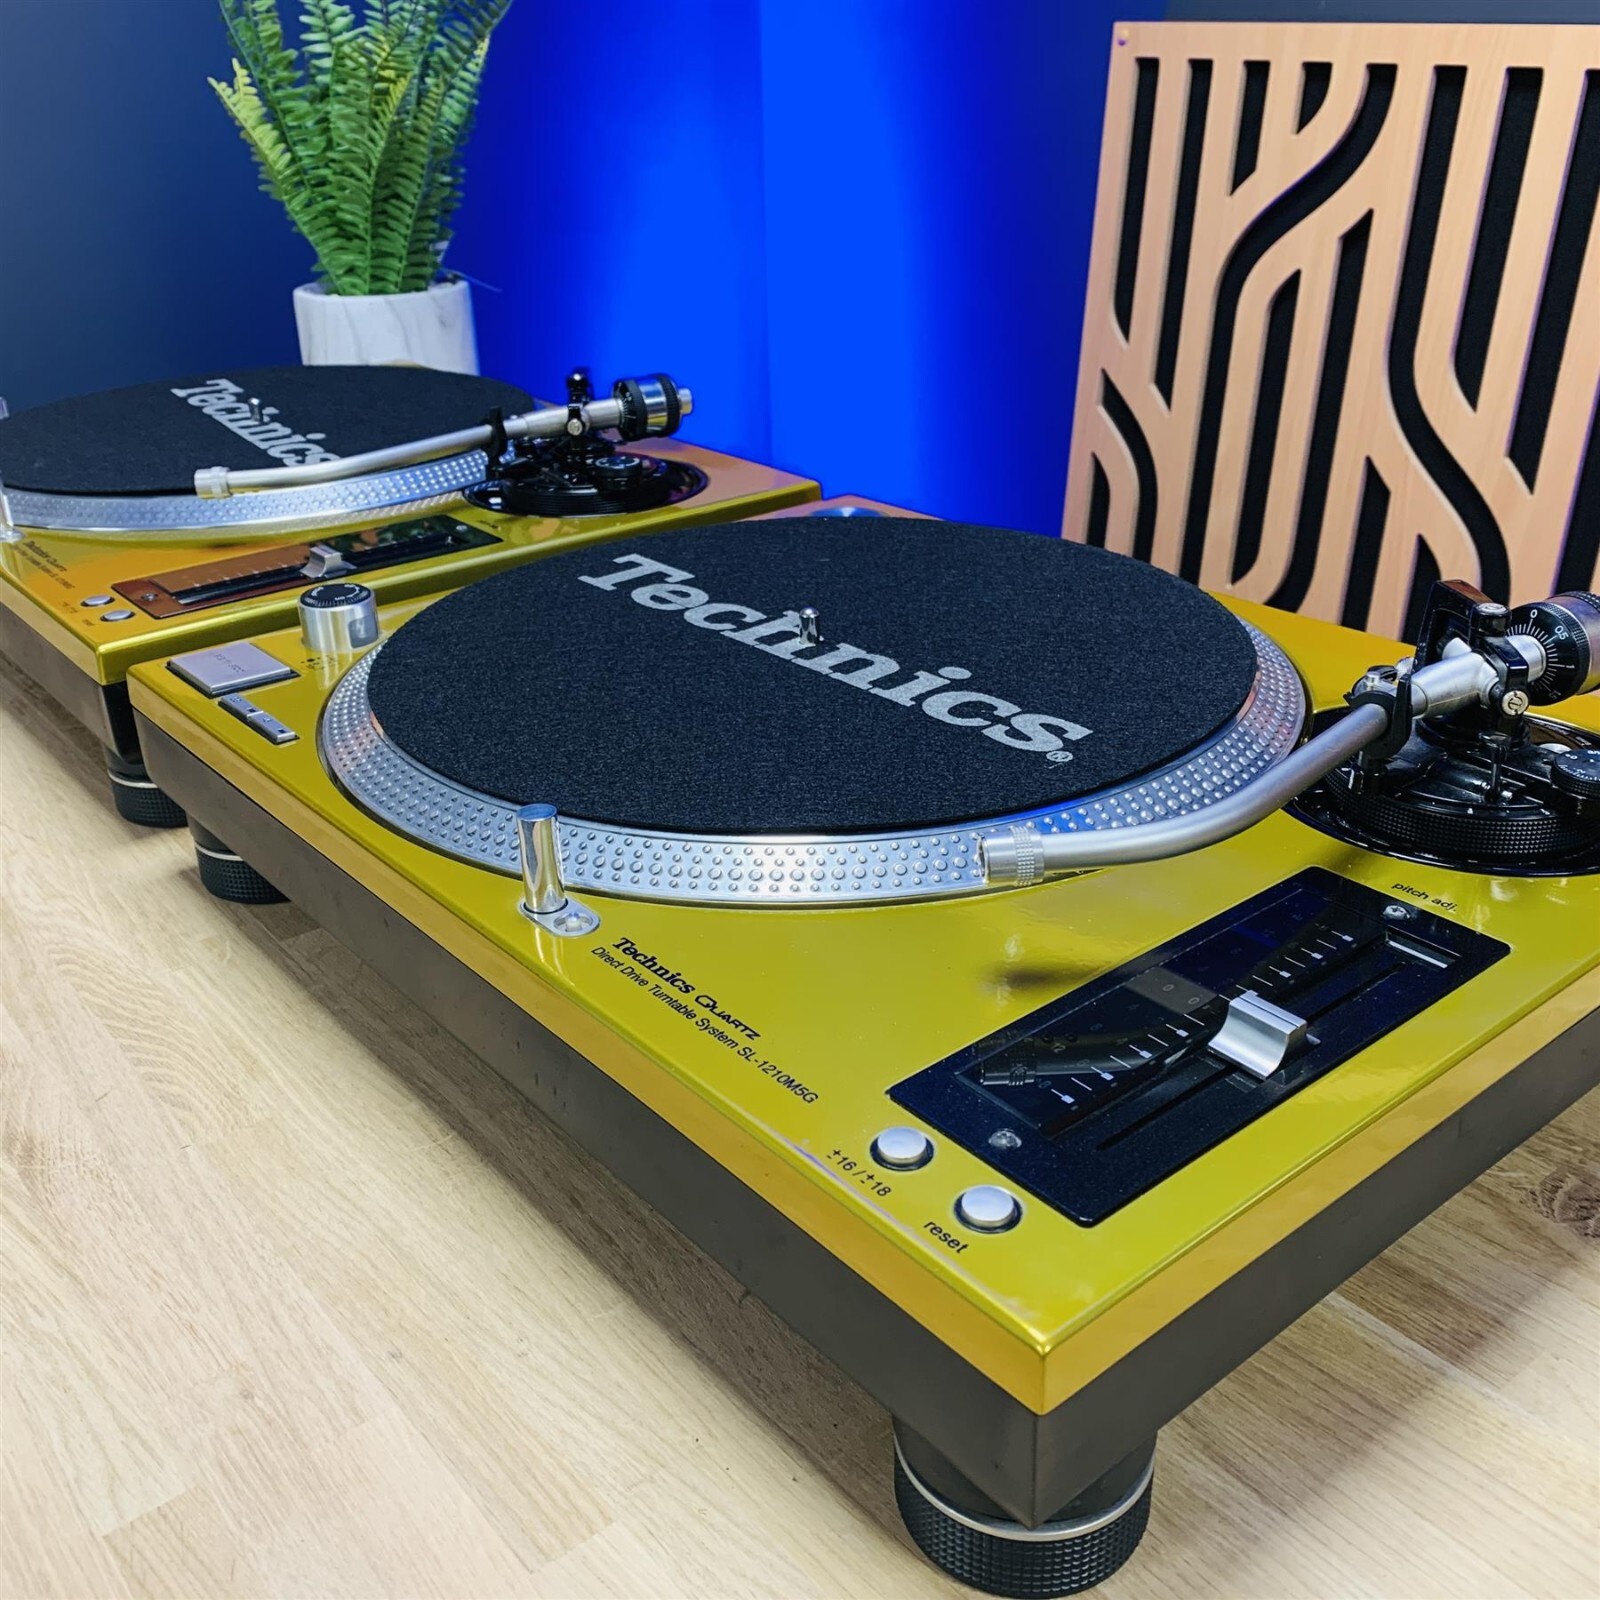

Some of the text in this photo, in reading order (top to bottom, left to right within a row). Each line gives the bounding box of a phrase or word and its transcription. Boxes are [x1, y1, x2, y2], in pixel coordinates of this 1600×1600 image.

[1530, 609, 1538, 618] 0
[1391, 882, 1457, 912] pitch adj.
[612, 936, 695, 994] Technics
[590, 946, 819, 1105] Direct Drive Turntable System SL-1210M5G
[923, 1220, 969, 1254] reset
